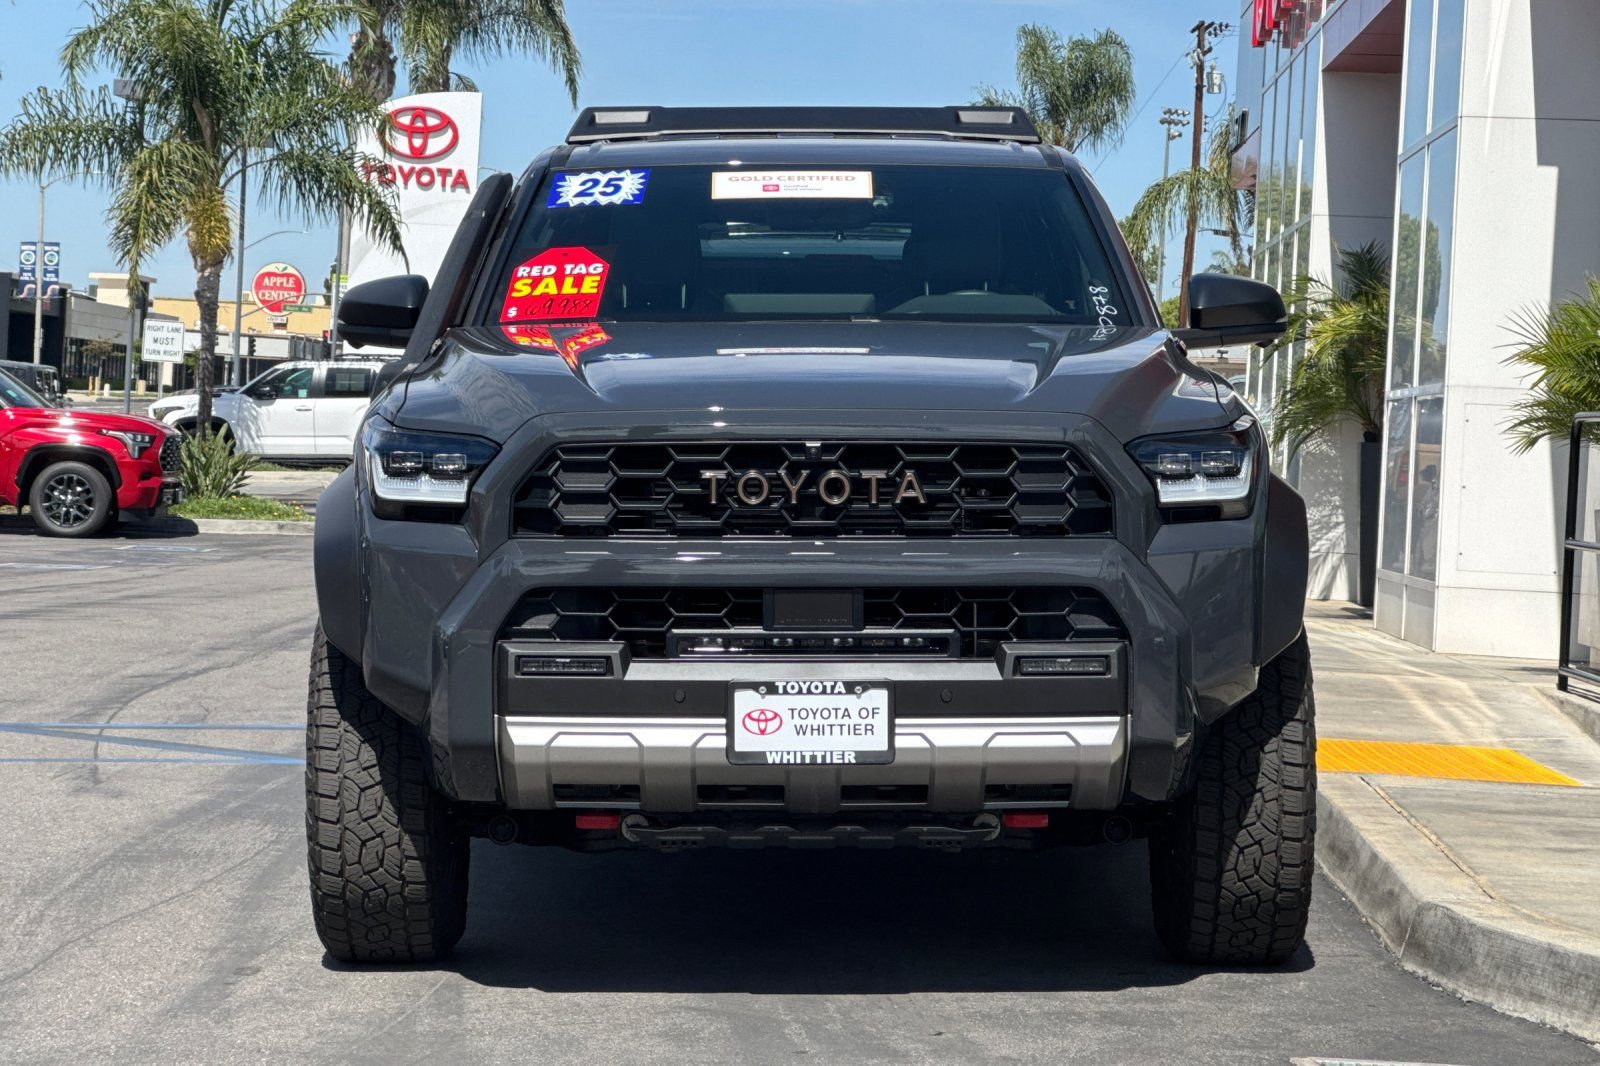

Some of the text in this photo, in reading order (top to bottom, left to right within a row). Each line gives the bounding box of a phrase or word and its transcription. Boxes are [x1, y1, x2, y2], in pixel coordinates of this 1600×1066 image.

[360, 161, 471, 190] TOYOTA
[573, 177, 625, 198] 25
[517, 263, 604, 277] RED TAG
[262, 276, 296, 288] APPLE
[511, 275, 601, 297] SALE
[258, 289, 298, 302] CENTER
[507, 307, 518, 318] $
[153, 336, 175, 346] MUST
[700, 469, 927, 505] TOYOTA
[775, 681, 847, 694] TOYOTA
[788, 707, 880, 720] TOYOTA OF
[793, 723, 875, 736] WHITTIER
[766, 751, 857, 764] WHITTIER
